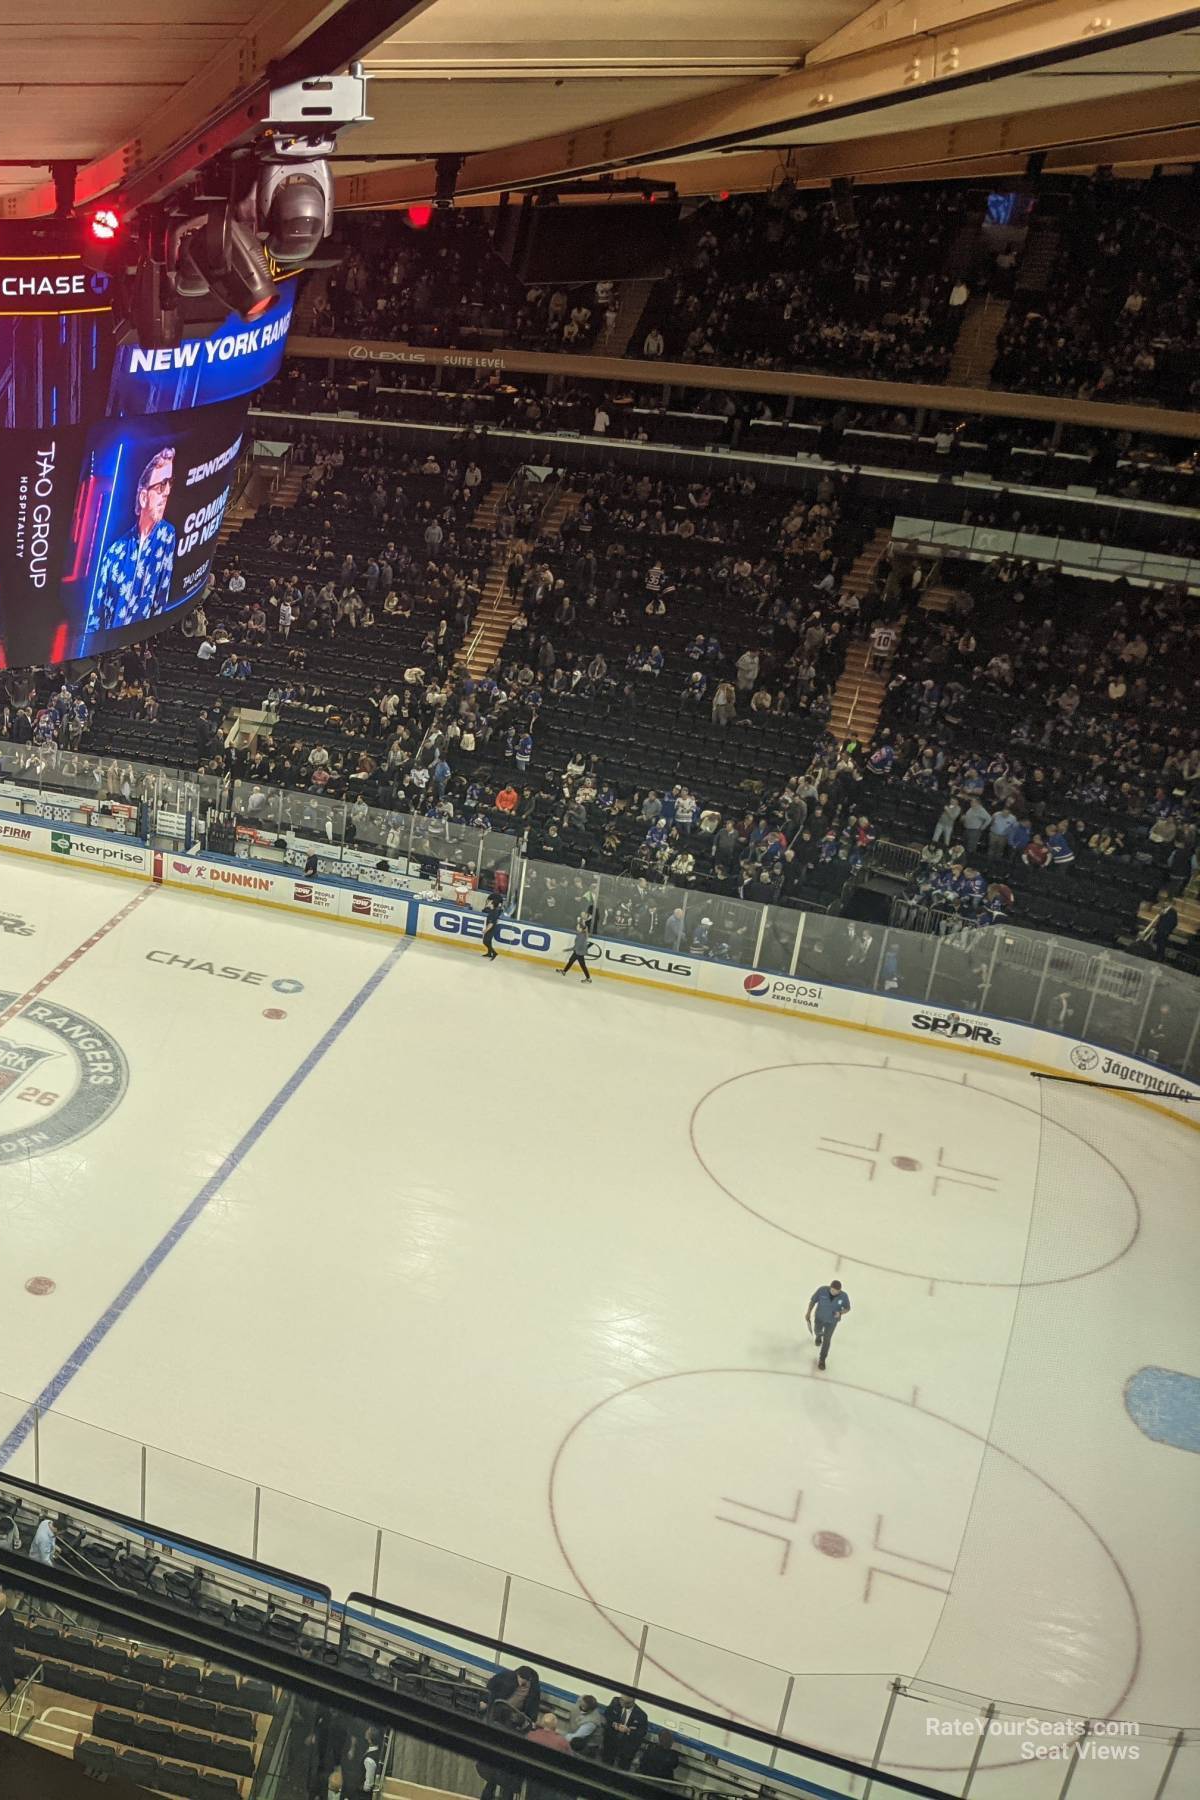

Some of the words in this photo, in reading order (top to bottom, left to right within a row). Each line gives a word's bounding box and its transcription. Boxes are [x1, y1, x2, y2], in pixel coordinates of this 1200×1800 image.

[1, 274, 86, 297] CHASE
[129, 342, 201, 373] NEW
[204, 328, 259, 364] YORK
[368, 350, 426, 363] LEXUS
[443, 354, 473, 368] SUITE
[475, 355, 506, 369] LEVEL
[35, 441, 56, 497] TAO
[16, 476, 28, 558] HOSPITALITY
[29, 504, 52, 588] GROUP
[177, 532, 199, 557] UP
[210, 868, 274, 892] DUNKIN'
[314, 890, 335, 899] PEOPLE
[373, 902, 395, 911] PEOPLE
[433, 911, 551, 952] GECO
[145, 950, 268, 986] CHASE
[605, 949, 692, 977] LEXUS
[771, 994, 792, 1004] ZERO
[793, 998, 820, 1008] SUGAR
[773, 979, 823, 1000] pepsi
[27, 1006, 114, 1086] RANGERS
[16, 1086, 60, 1107] 26
